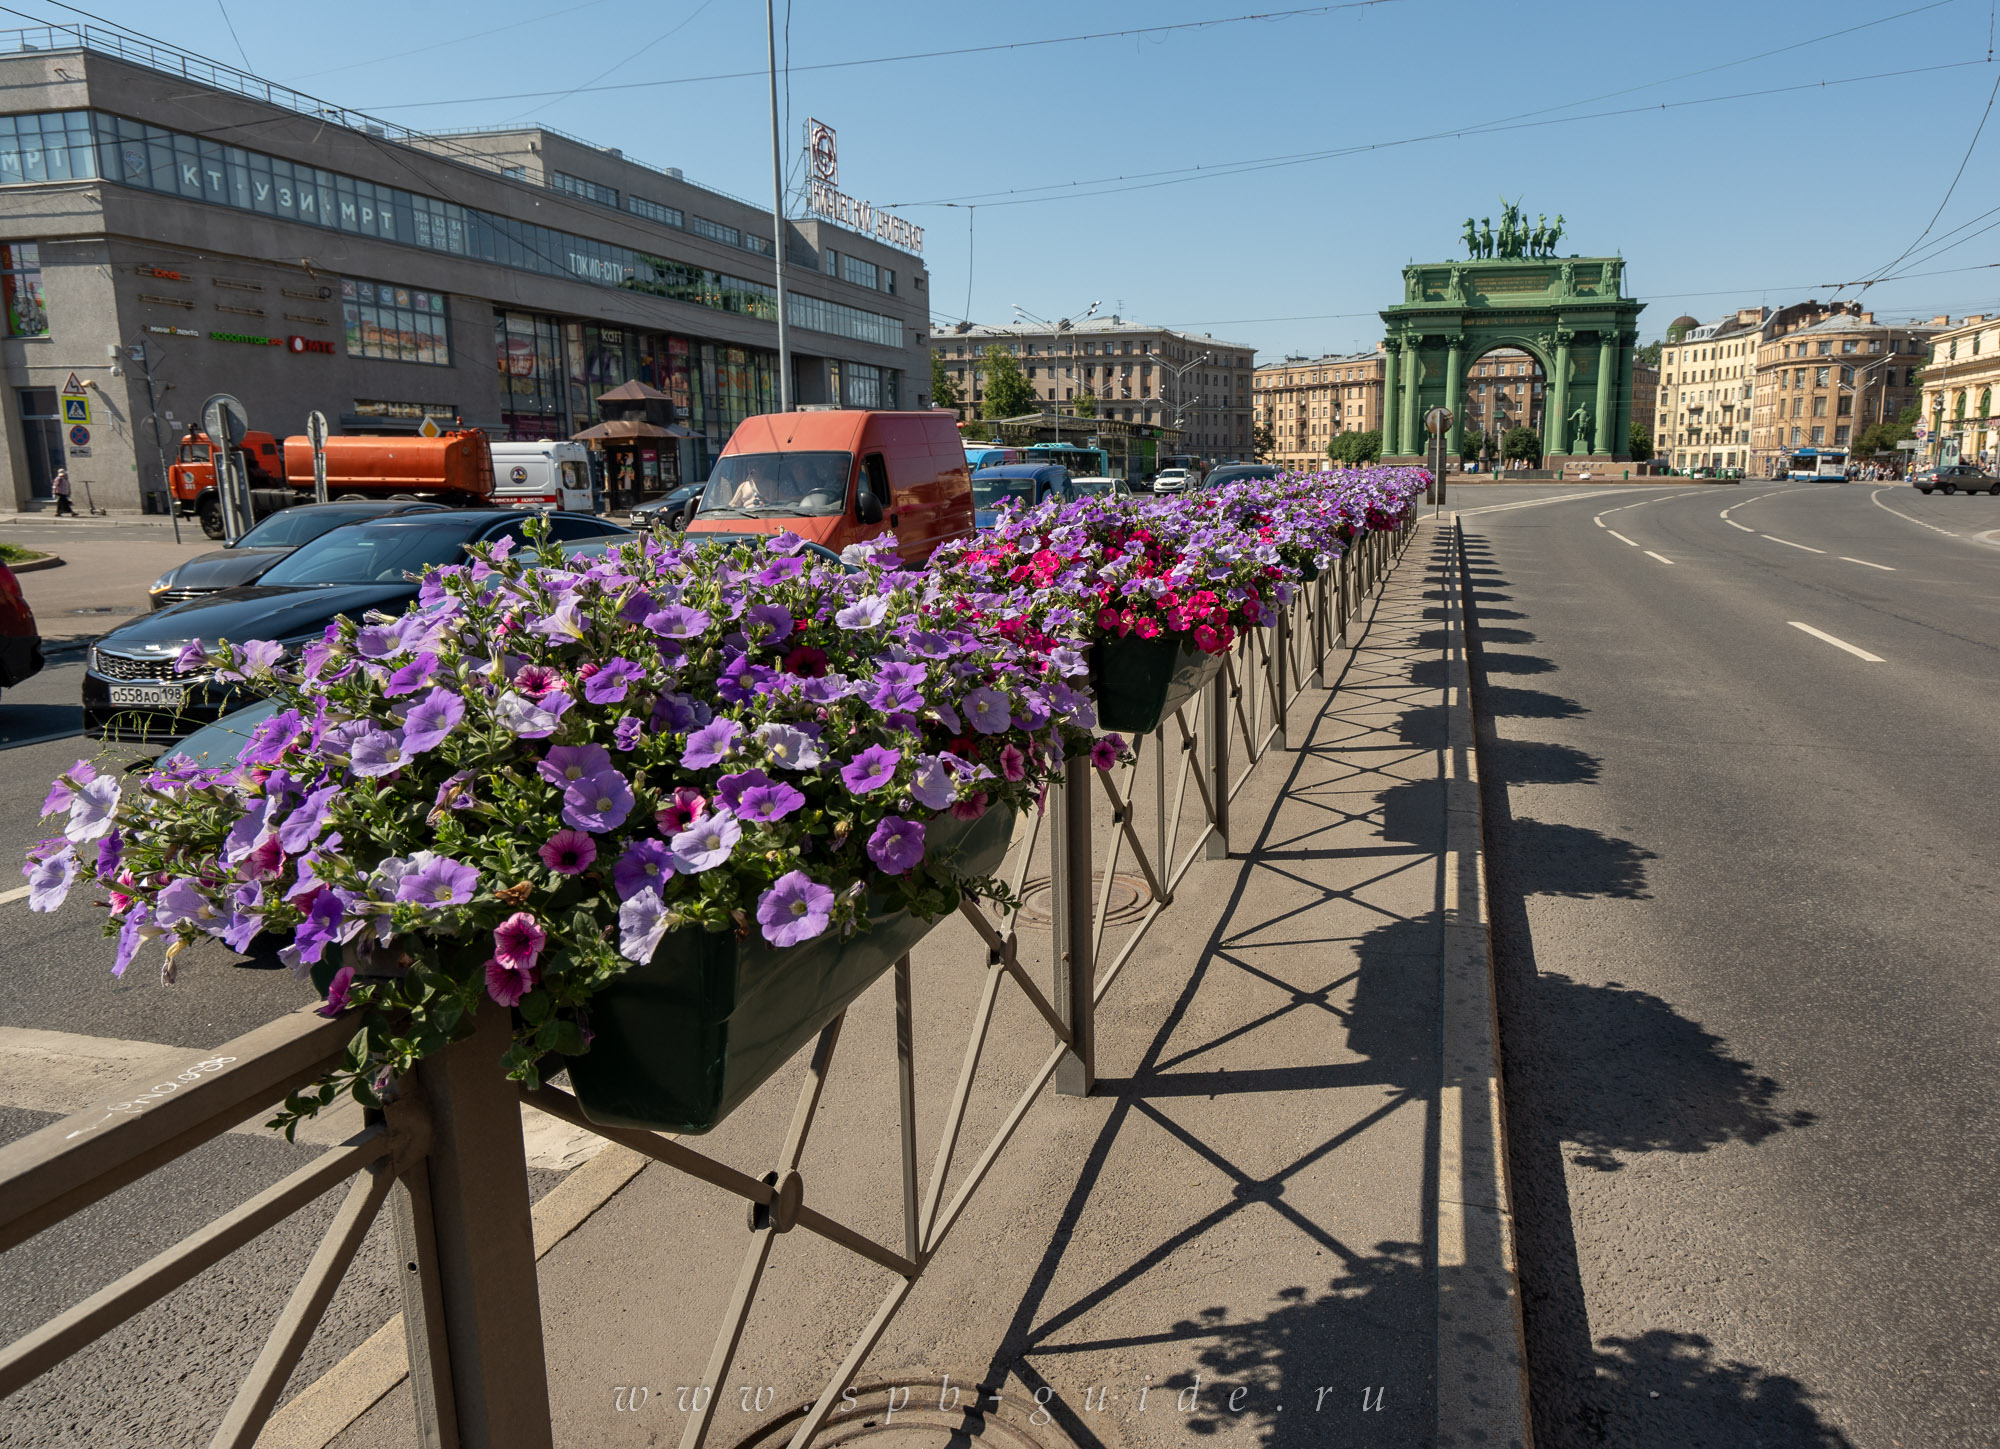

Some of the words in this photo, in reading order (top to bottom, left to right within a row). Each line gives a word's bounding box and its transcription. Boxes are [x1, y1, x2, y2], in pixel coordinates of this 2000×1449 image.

[0, 146, 63, 172] МРТ
[182, 164, 221, 191] КТ
[255, 181, 313, 213] УЗИ
[341, 202, 391, 230] МРТ
[307, 338, 336, 355] МТС
